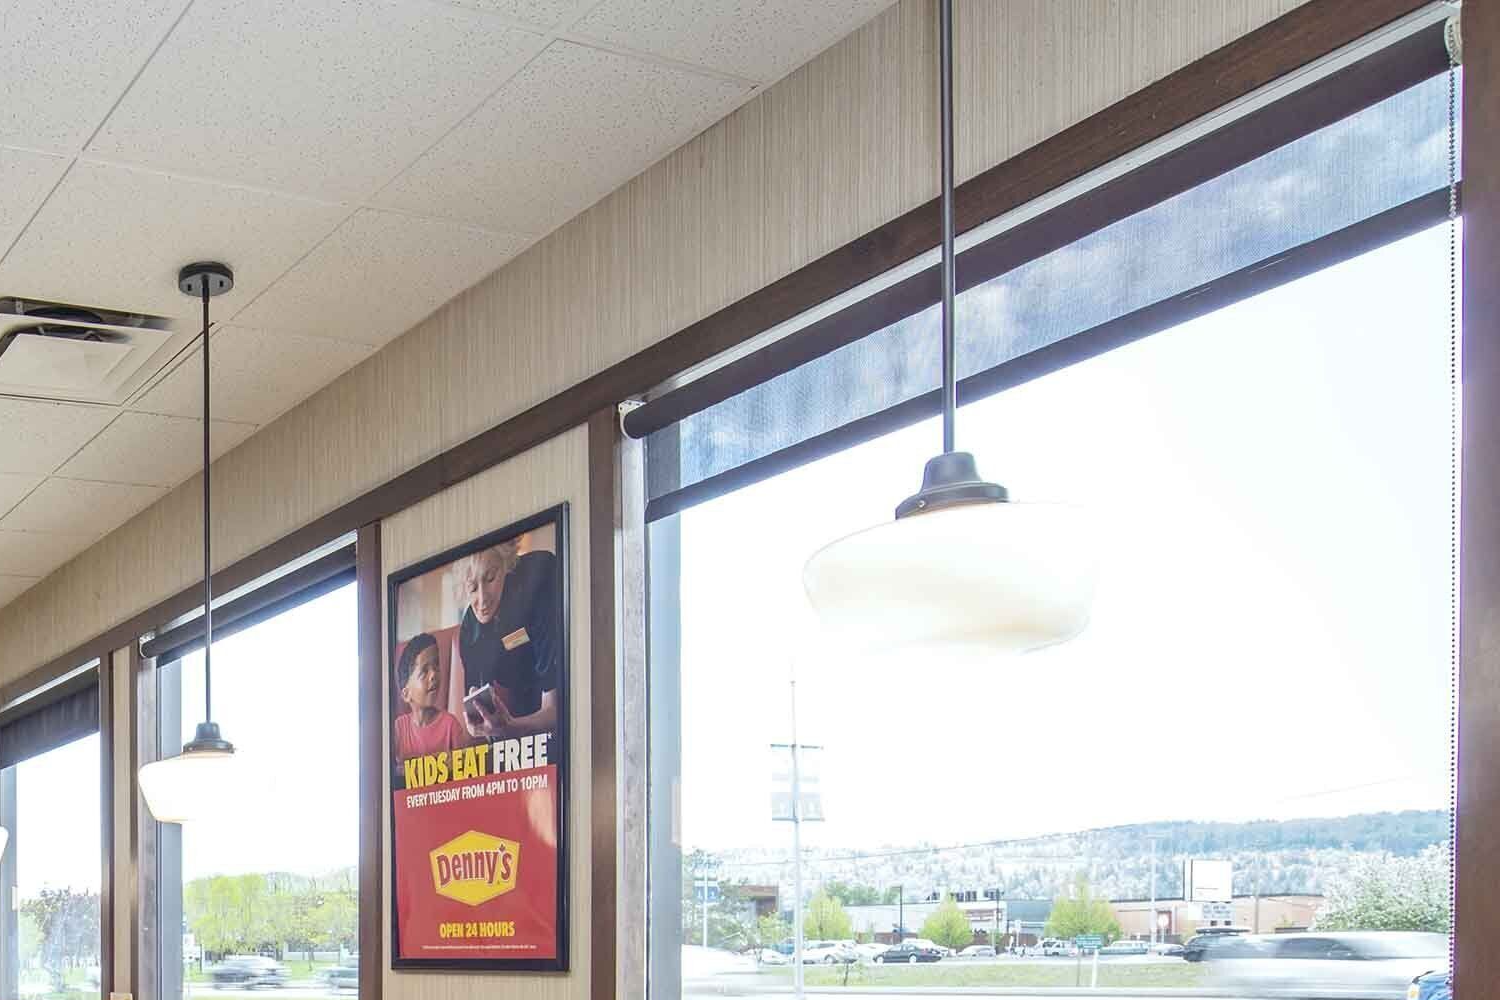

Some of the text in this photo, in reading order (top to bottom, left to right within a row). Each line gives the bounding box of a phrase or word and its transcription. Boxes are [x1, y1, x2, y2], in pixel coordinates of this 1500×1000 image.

[404, 751, 448, 790] KIDS
[453, 743, 489, 781] EAT
[406, 774, 548, 809] EVERY TUESDAY FROM 4PM TO 10PM
[436, 843, 513, 887] Denny's
[439, 921, 516, 939] OPEN 24 HOURS
